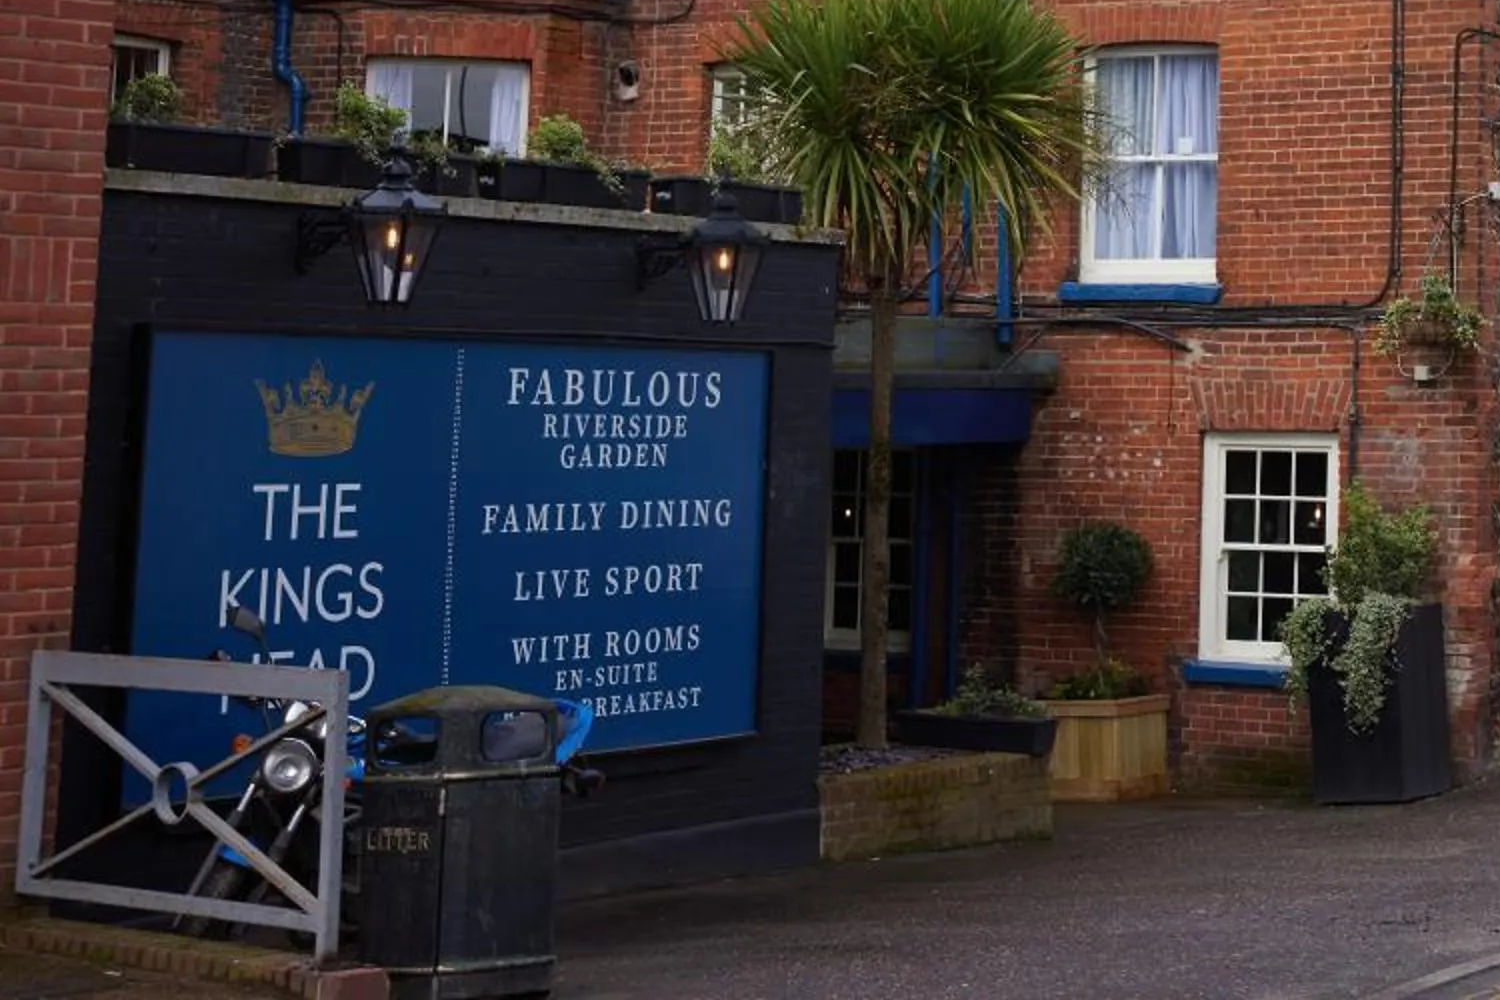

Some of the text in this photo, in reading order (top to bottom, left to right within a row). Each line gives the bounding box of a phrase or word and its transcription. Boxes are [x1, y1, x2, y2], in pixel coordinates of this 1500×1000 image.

[507, 367, 722, 408] FABULOUS
[543, 413, 688, 439] RIVERSIDE
[560, 443, 669, 469] GARDEN
[252, 483, 362, 541] THE
[481, 499, 732, 534] FAMILY DINING
[219, 561, 385, 628] KINGS
[514, 563, 703, 601] LIVE SPORT
[511, 624, 701, 665] WITH ROOMS
[554, 661, 658, 691] EN-SUITE
[366, 827, 430, 852] LITTER
